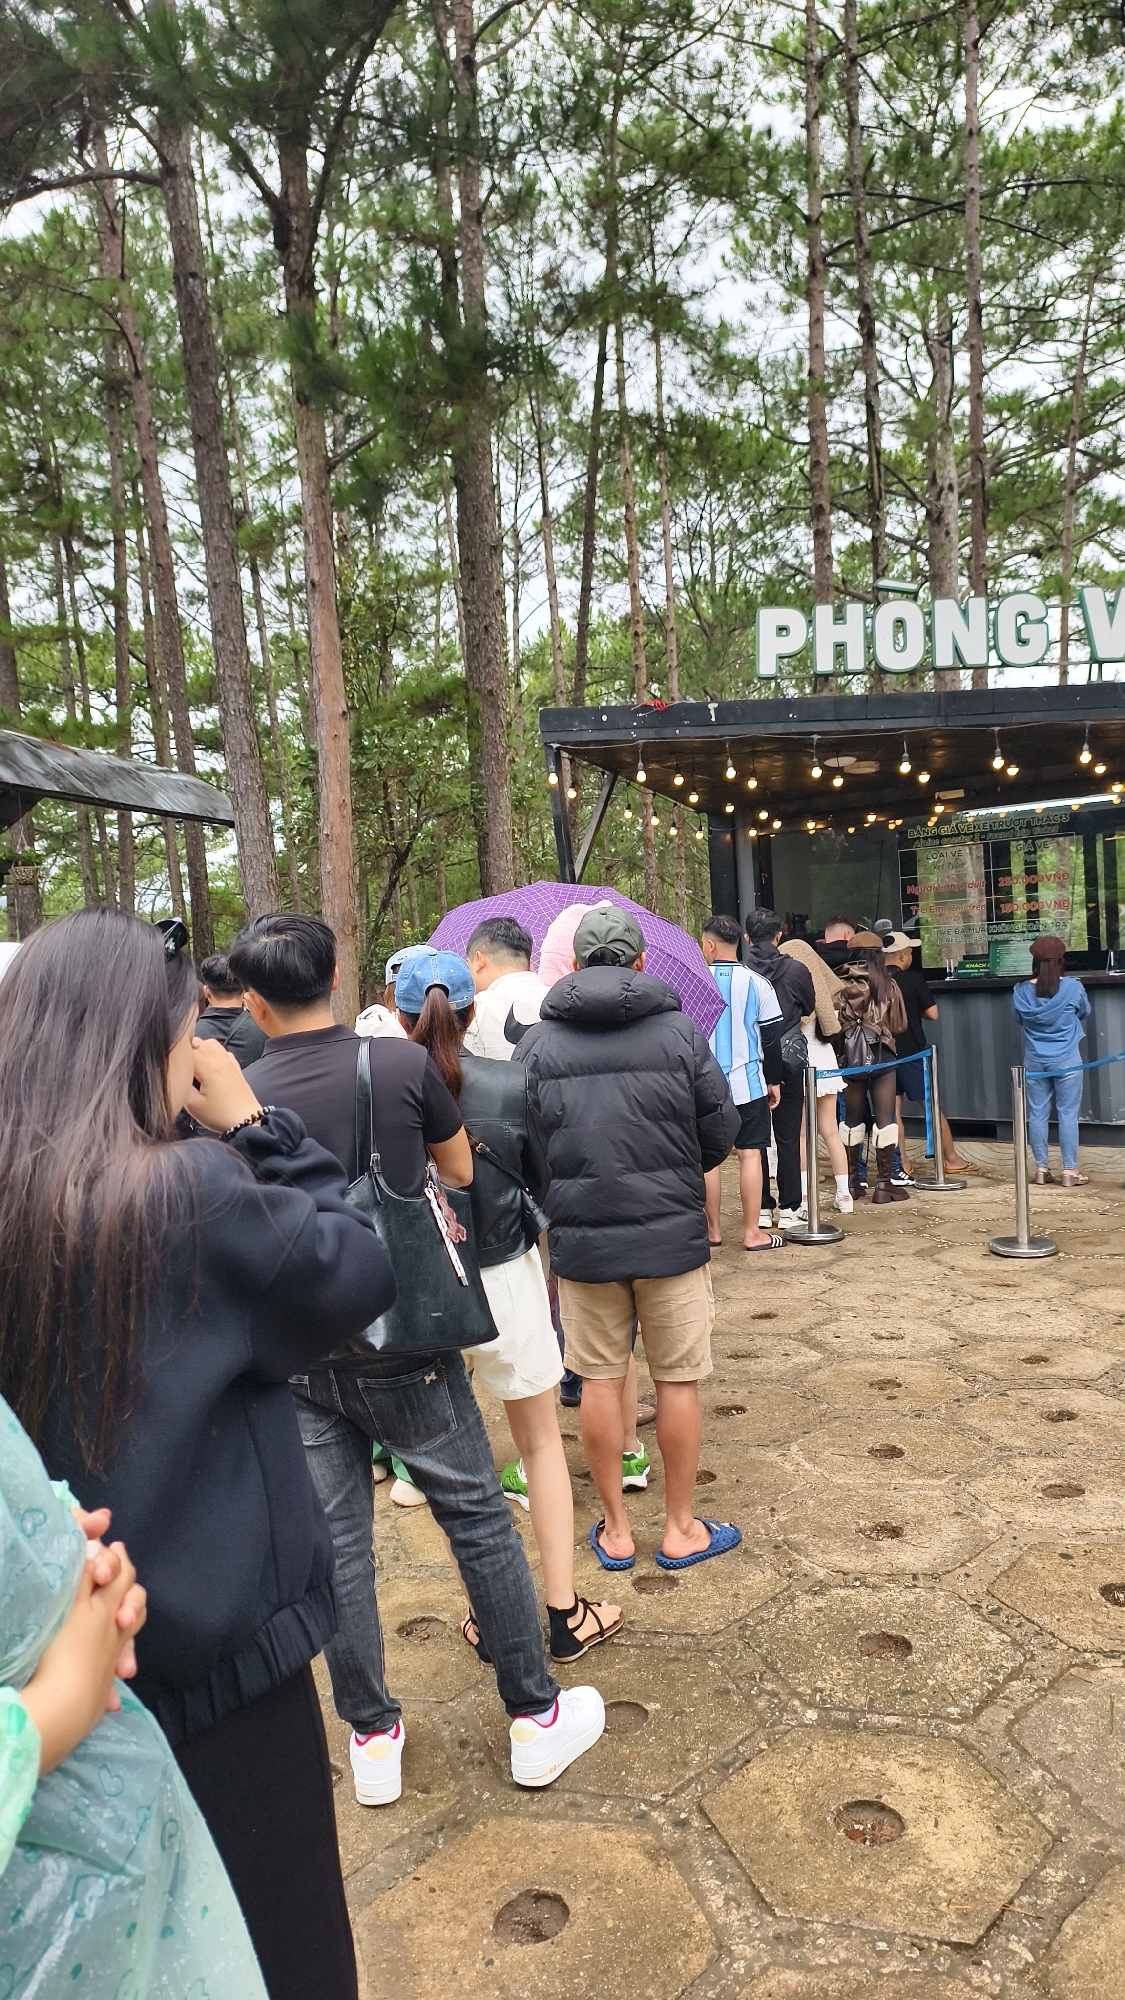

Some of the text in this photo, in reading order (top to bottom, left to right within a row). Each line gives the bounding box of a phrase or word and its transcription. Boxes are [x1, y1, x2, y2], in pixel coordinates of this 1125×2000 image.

[756, 577, 1049, 679] PHÒNG
[938, 822, 958, 836] GIÁ
[974, 820, 990, 832] XE
[1061, 812, 1070, 823] 3
[1015, 839, 1034, 852] GIÁ
[925, 851, 948, 861] LOẠI
[968, 926, 986, 934] MUA
